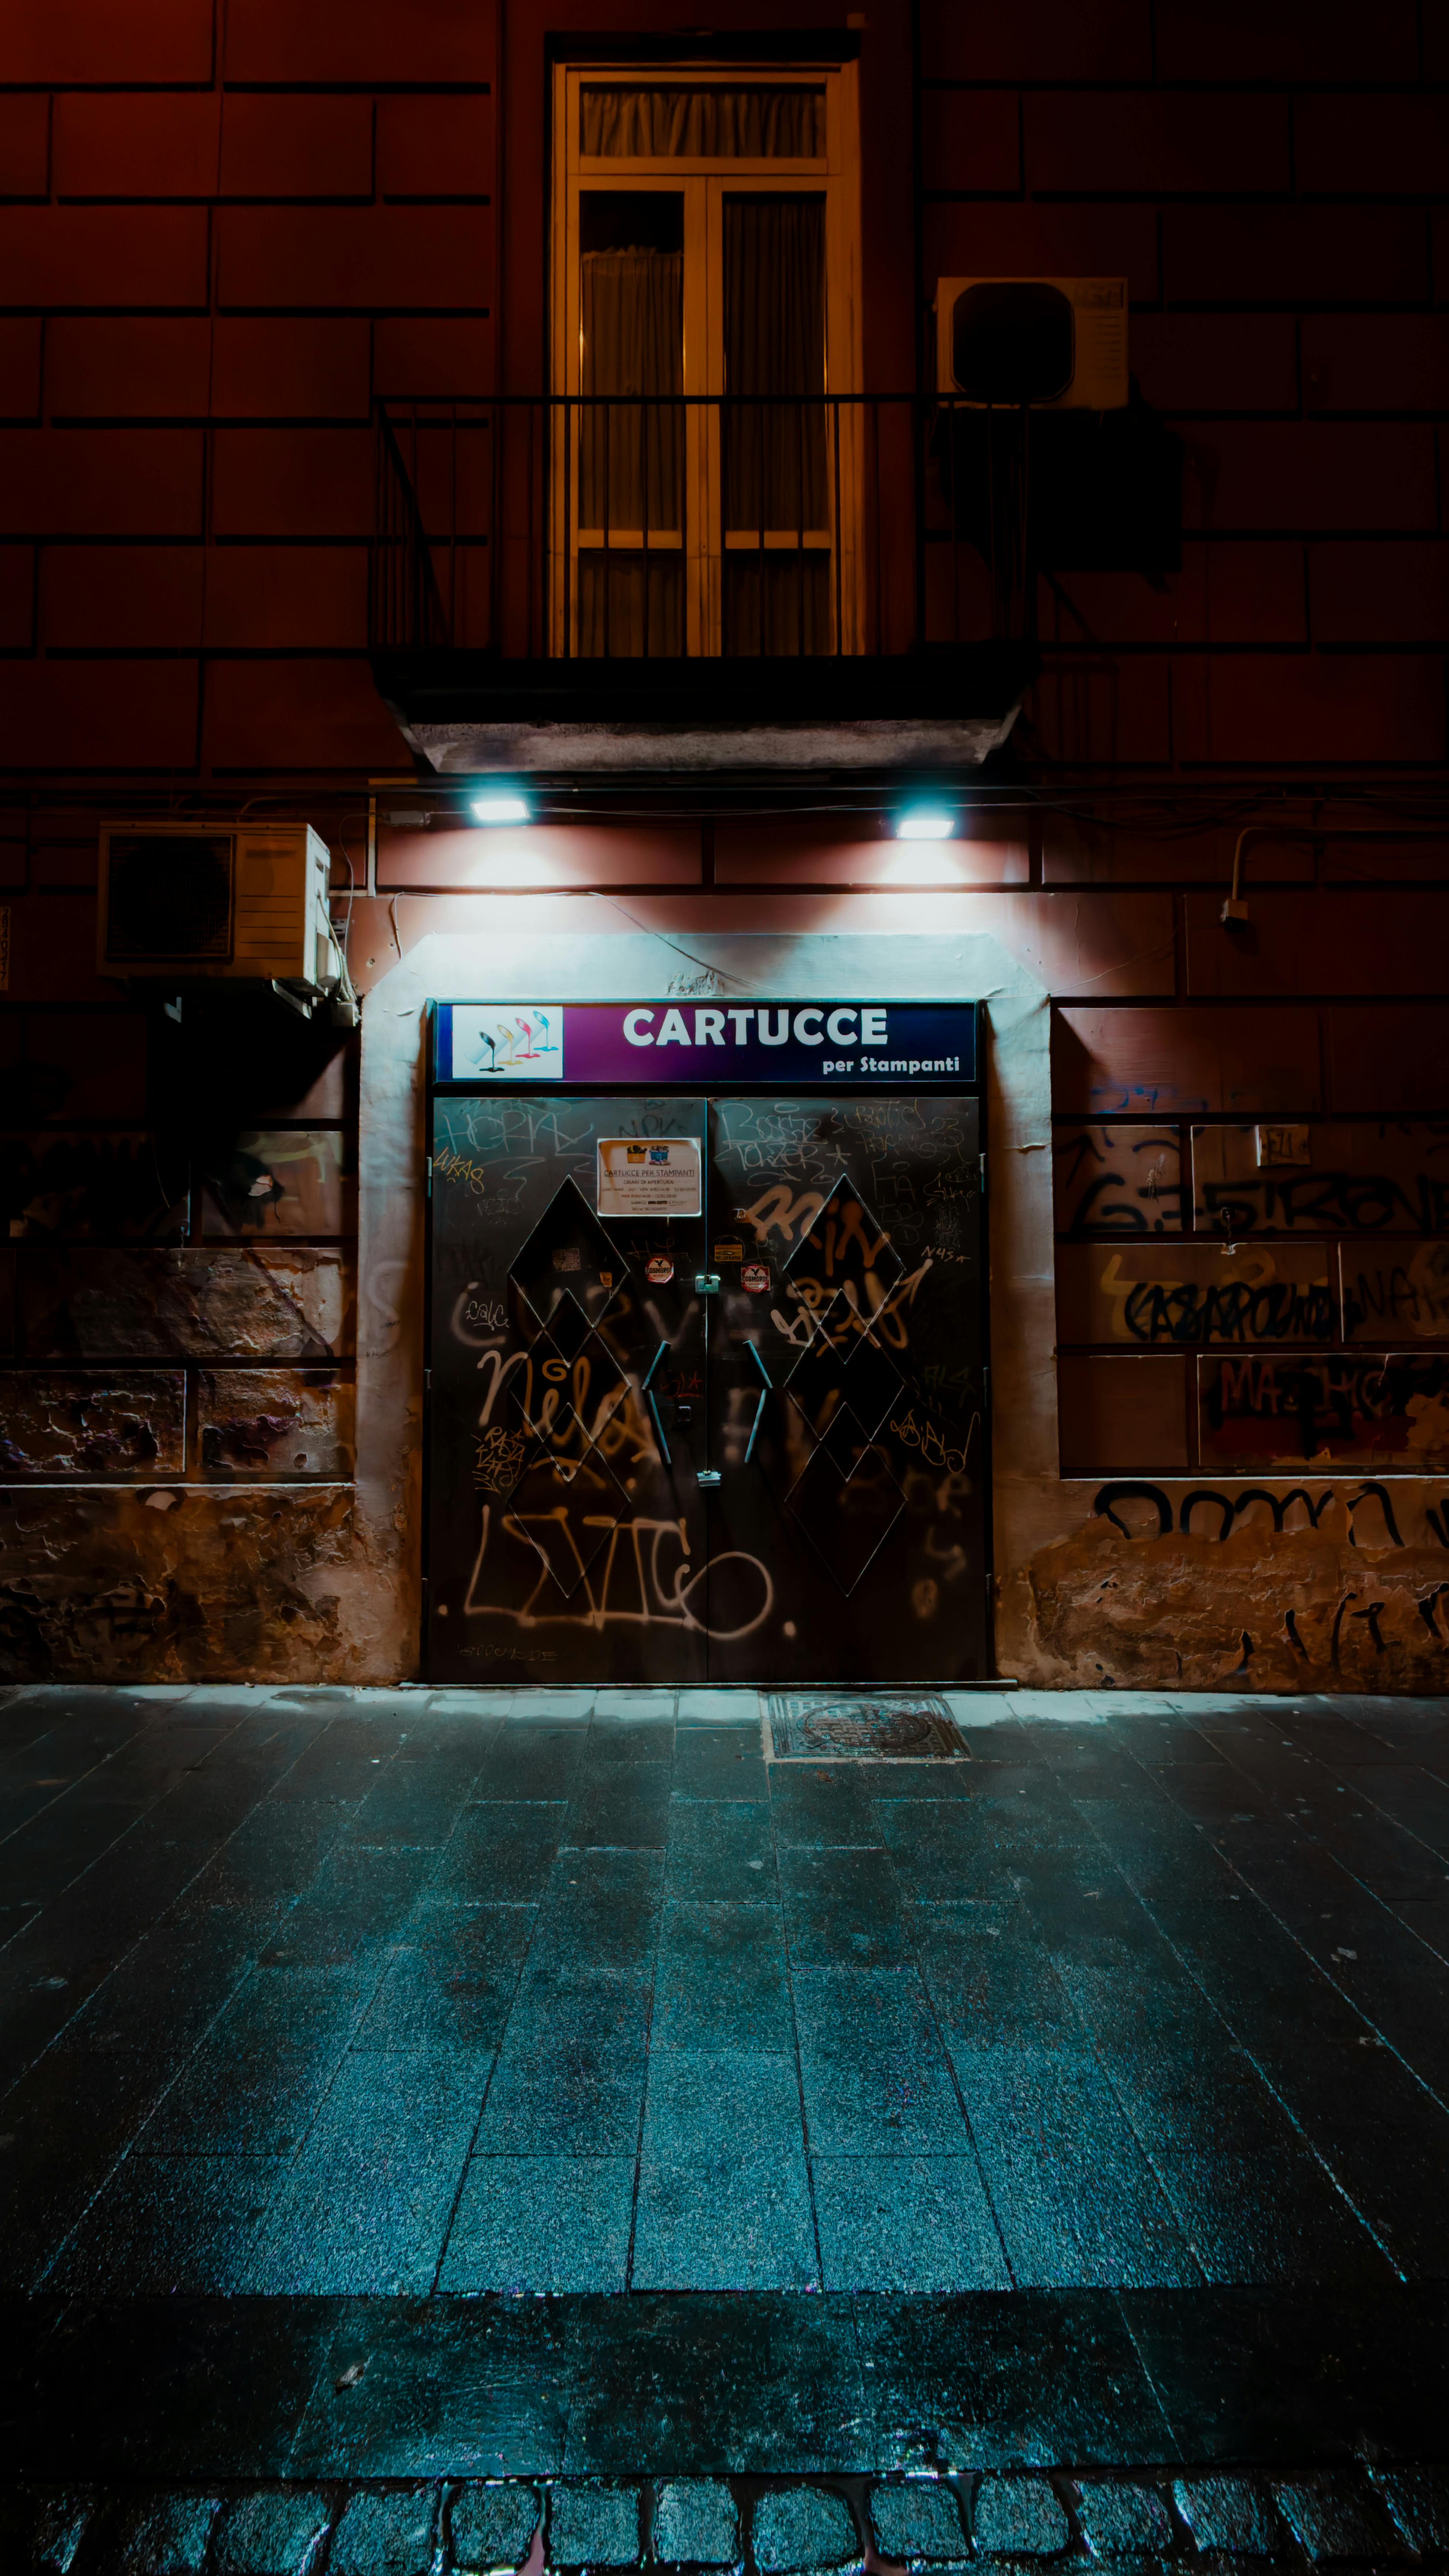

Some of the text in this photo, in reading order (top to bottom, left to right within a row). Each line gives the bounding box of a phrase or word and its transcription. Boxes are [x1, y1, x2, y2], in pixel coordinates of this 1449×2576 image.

[623, 1008, 888, 1046] CARTUCCE
[823, 1056, 960, 1075] per Stampanti
